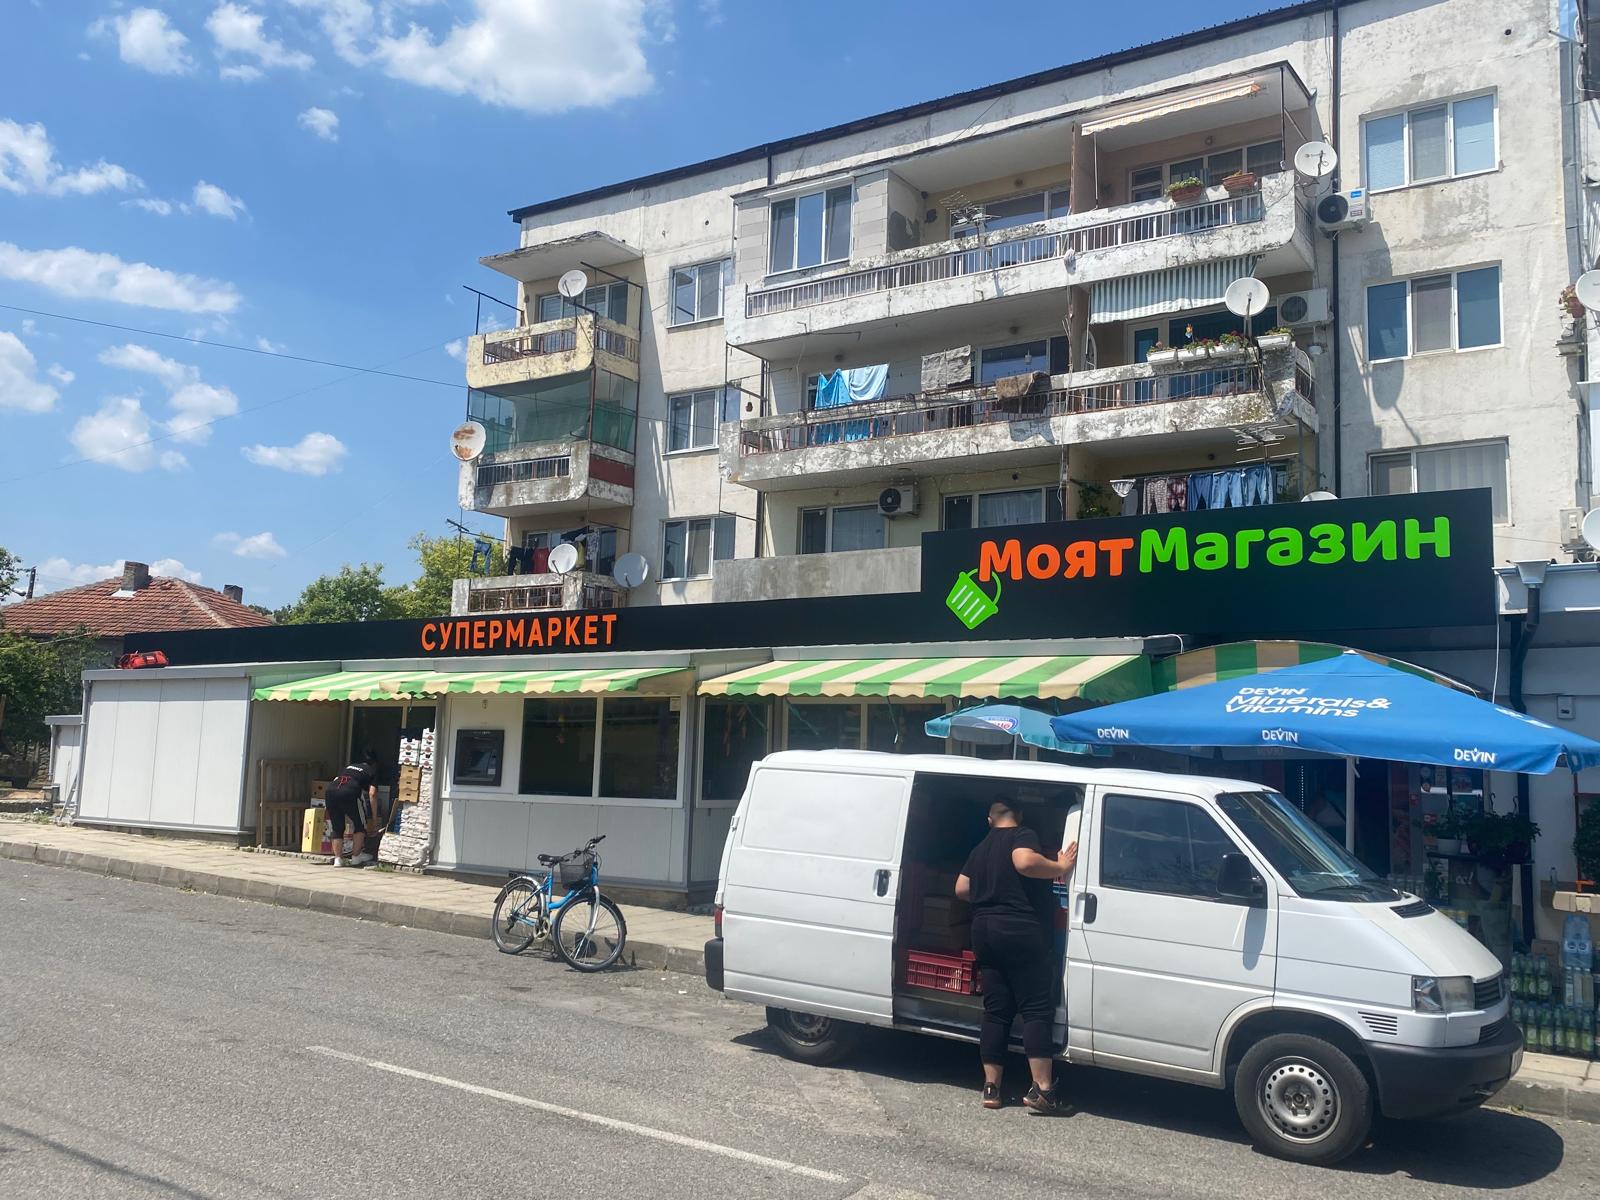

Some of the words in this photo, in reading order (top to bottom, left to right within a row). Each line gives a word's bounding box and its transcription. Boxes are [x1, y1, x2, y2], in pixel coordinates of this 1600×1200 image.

[421, 614, 617, 651] СУПЕРМАРКЕТ
[1239, 687, 1309, 696] DEVIN
[1225, 704, 1360, 717] Vitamins
[1097, 727, 1129, 739] DEVIN
[1261, 729, 1298, 743] DEVIN
[1454, 748, 1496, 764] DEVIN
